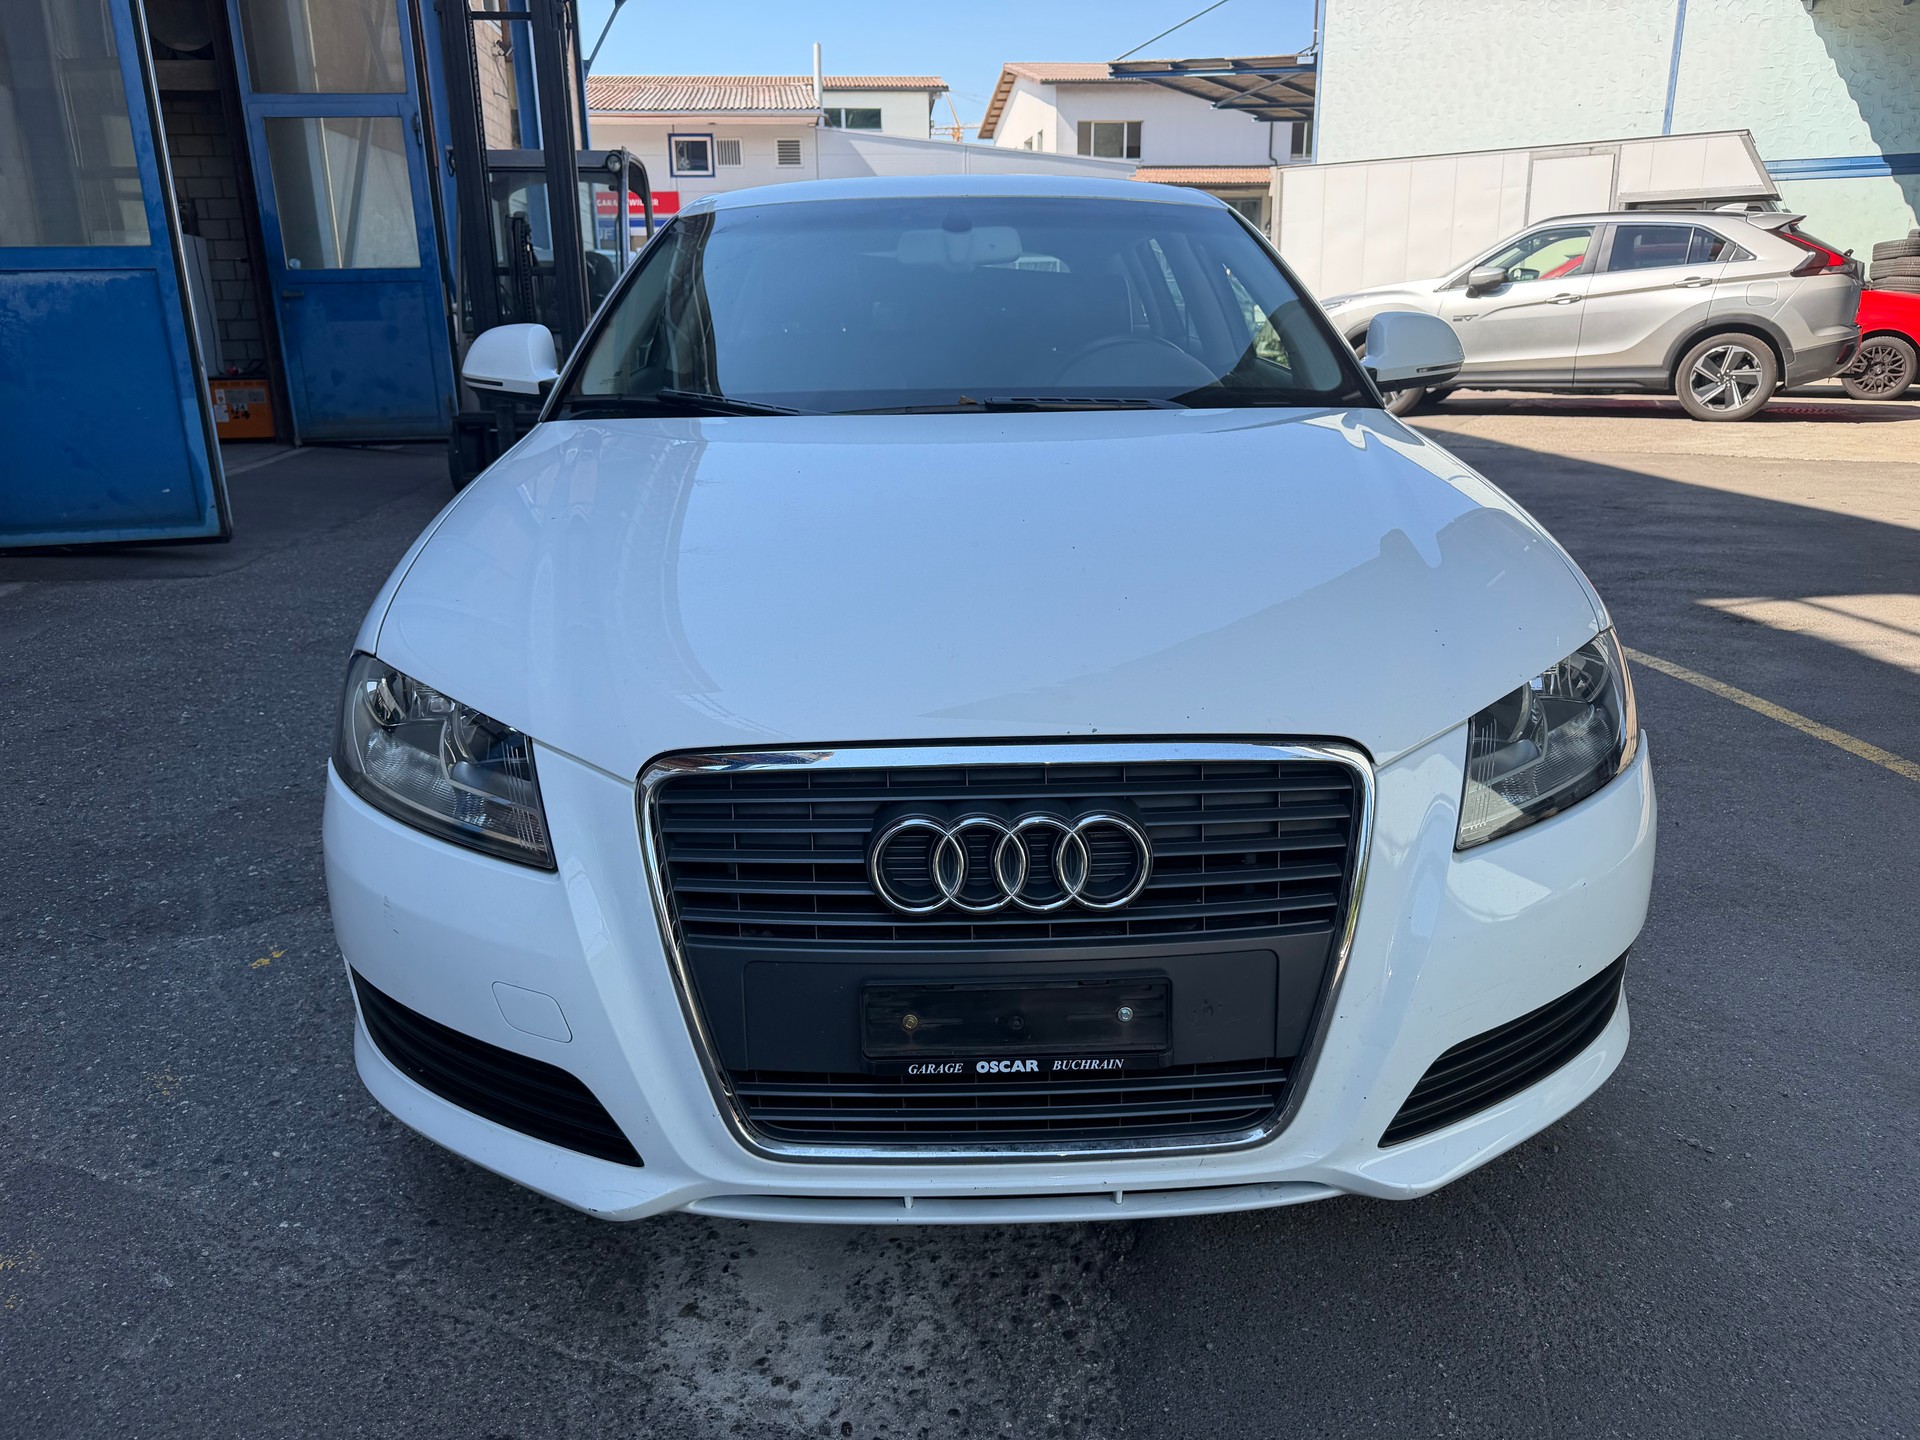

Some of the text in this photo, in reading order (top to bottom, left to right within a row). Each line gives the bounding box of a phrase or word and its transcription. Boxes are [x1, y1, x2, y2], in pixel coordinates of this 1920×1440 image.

[908, 1058, 1125, 1075] GARAGE OSCAR BUCHRAIN
